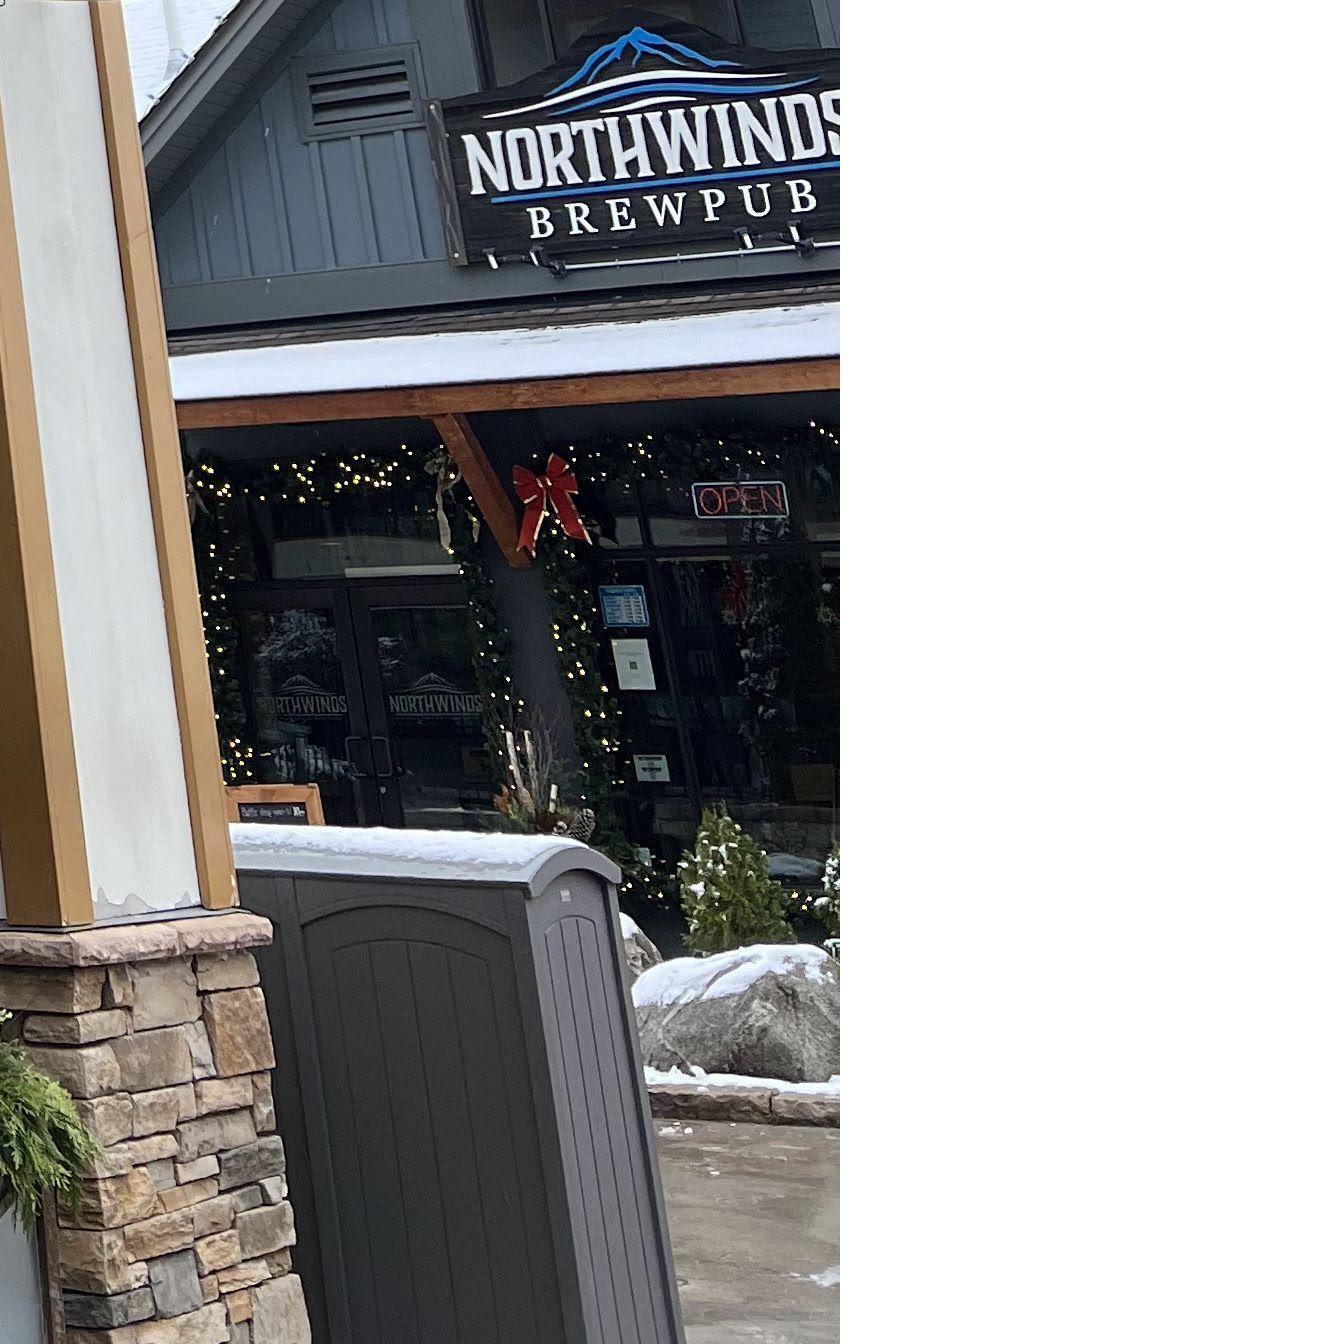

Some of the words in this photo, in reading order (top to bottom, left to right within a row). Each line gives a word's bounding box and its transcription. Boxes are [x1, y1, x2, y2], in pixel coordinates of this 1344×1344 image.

[525, 179, 817, 239] BREWPUB
[699, 484, 784, 515] OPEN
[388, 693, 483, 713] NORTHWINDS
